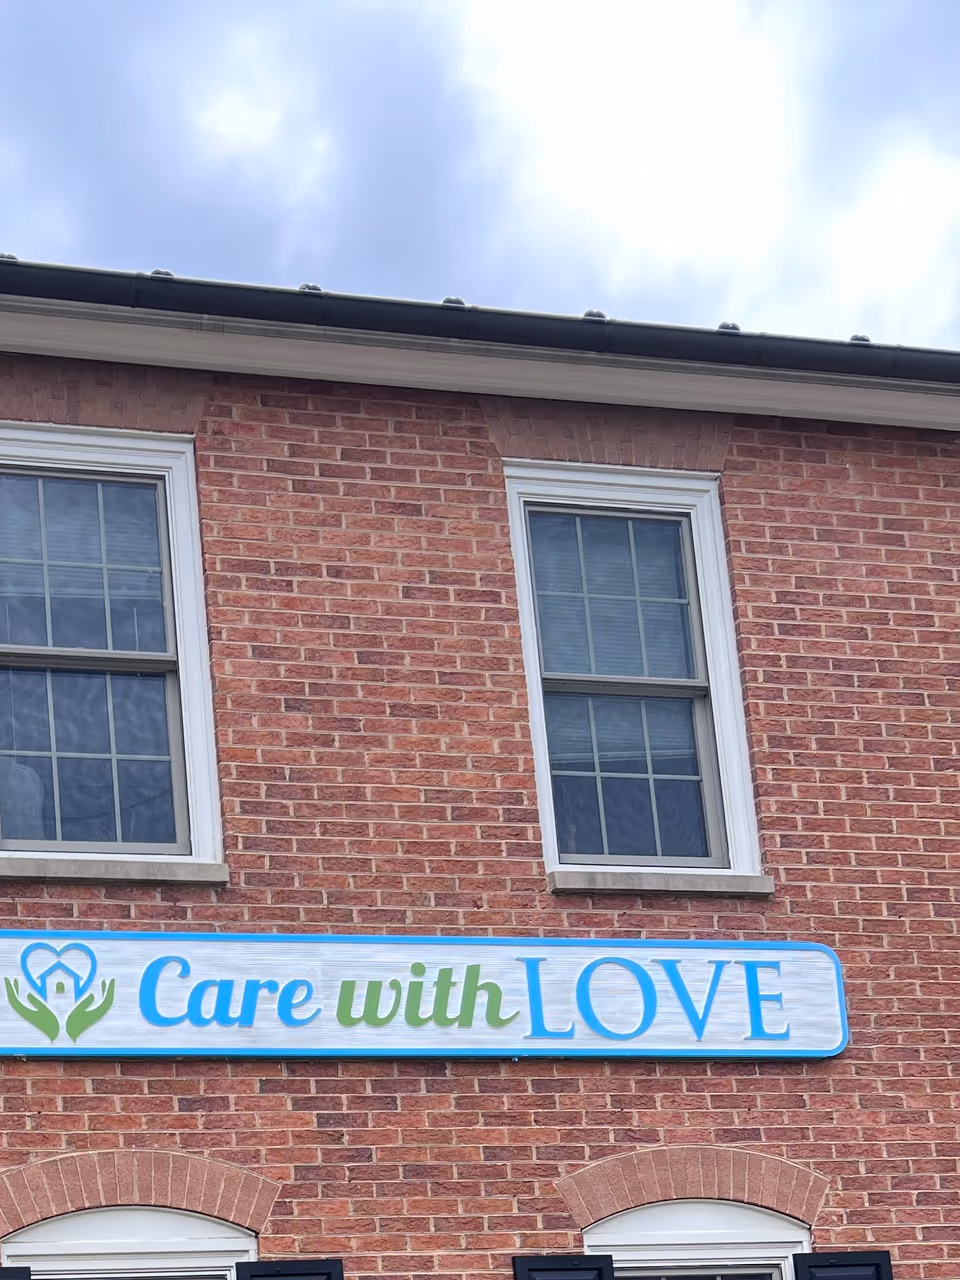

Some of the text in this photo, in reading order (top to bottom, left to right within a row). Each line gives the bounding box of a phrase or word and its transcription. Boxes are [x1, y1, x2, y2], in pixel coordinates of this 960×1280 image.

[139, 955, 791, 1041] Care with LOVE
